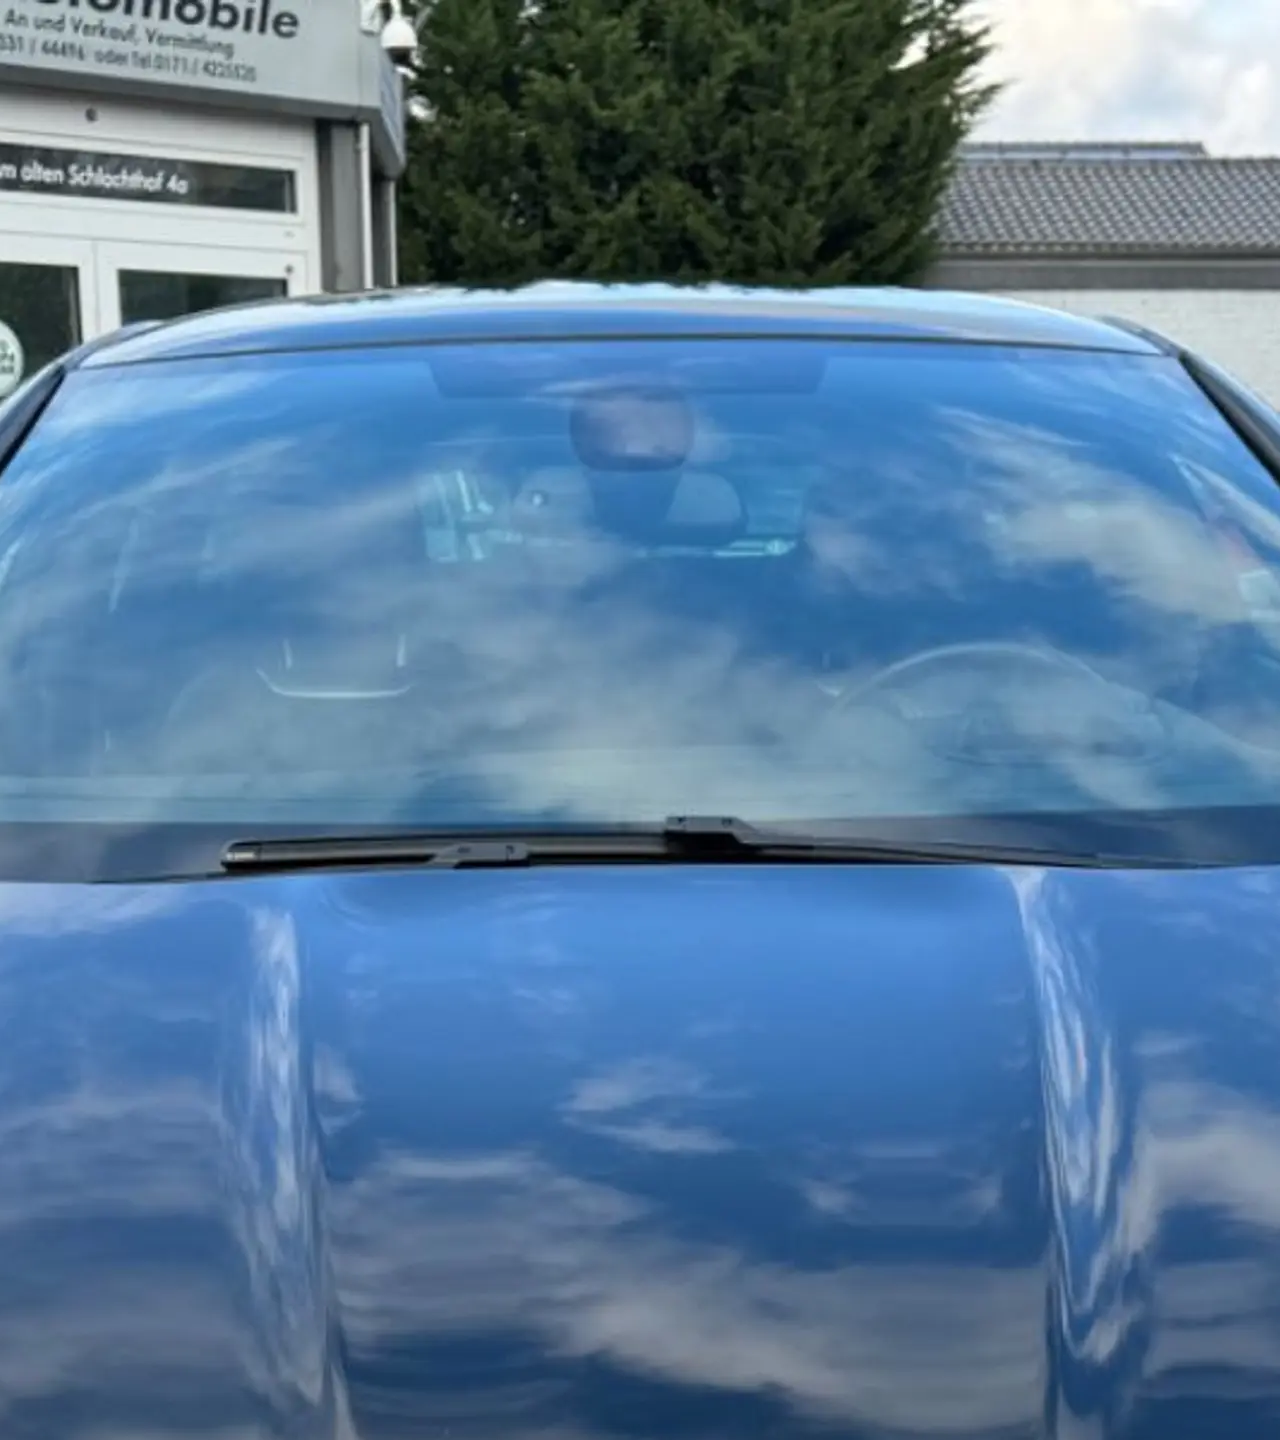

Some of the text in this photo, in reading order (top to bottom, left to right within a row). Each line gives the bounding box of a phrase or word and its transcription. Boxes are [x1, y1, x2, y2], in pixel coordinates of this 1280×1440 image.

[33, 14, 65, 33] und
[20, 160, 64, 184] alten
[67, 163, 163, 193] Schlachthof
[167, 173, 189, 195] 4a
